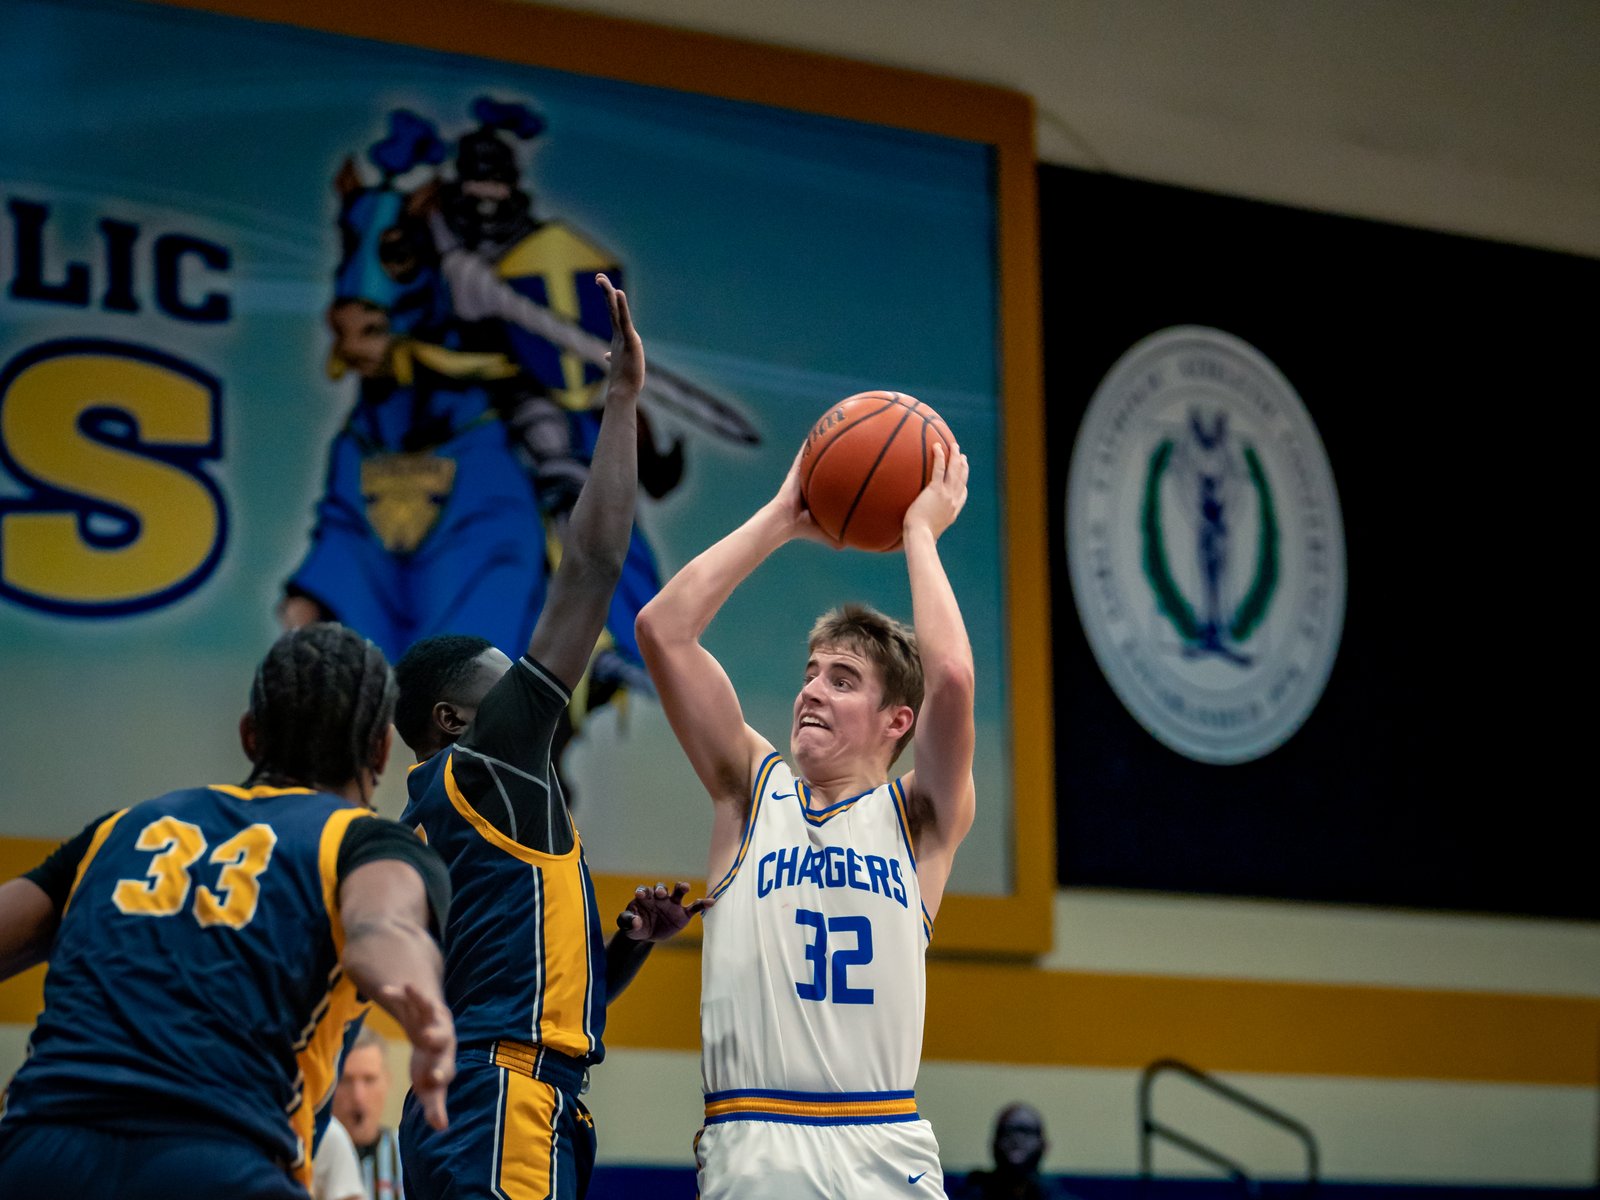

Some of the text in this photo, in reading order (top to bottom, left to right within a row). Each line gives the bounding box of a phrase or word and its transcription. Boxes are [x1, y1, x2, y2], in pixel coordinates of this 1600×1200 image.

[7, 197, 232, 323] LIC
[0, 336, 229, 618] S
[111, 815, 278, 931] 33
[757, 845, 909, 909] CHARGERS
[795, 908, 875, 1005] 32
